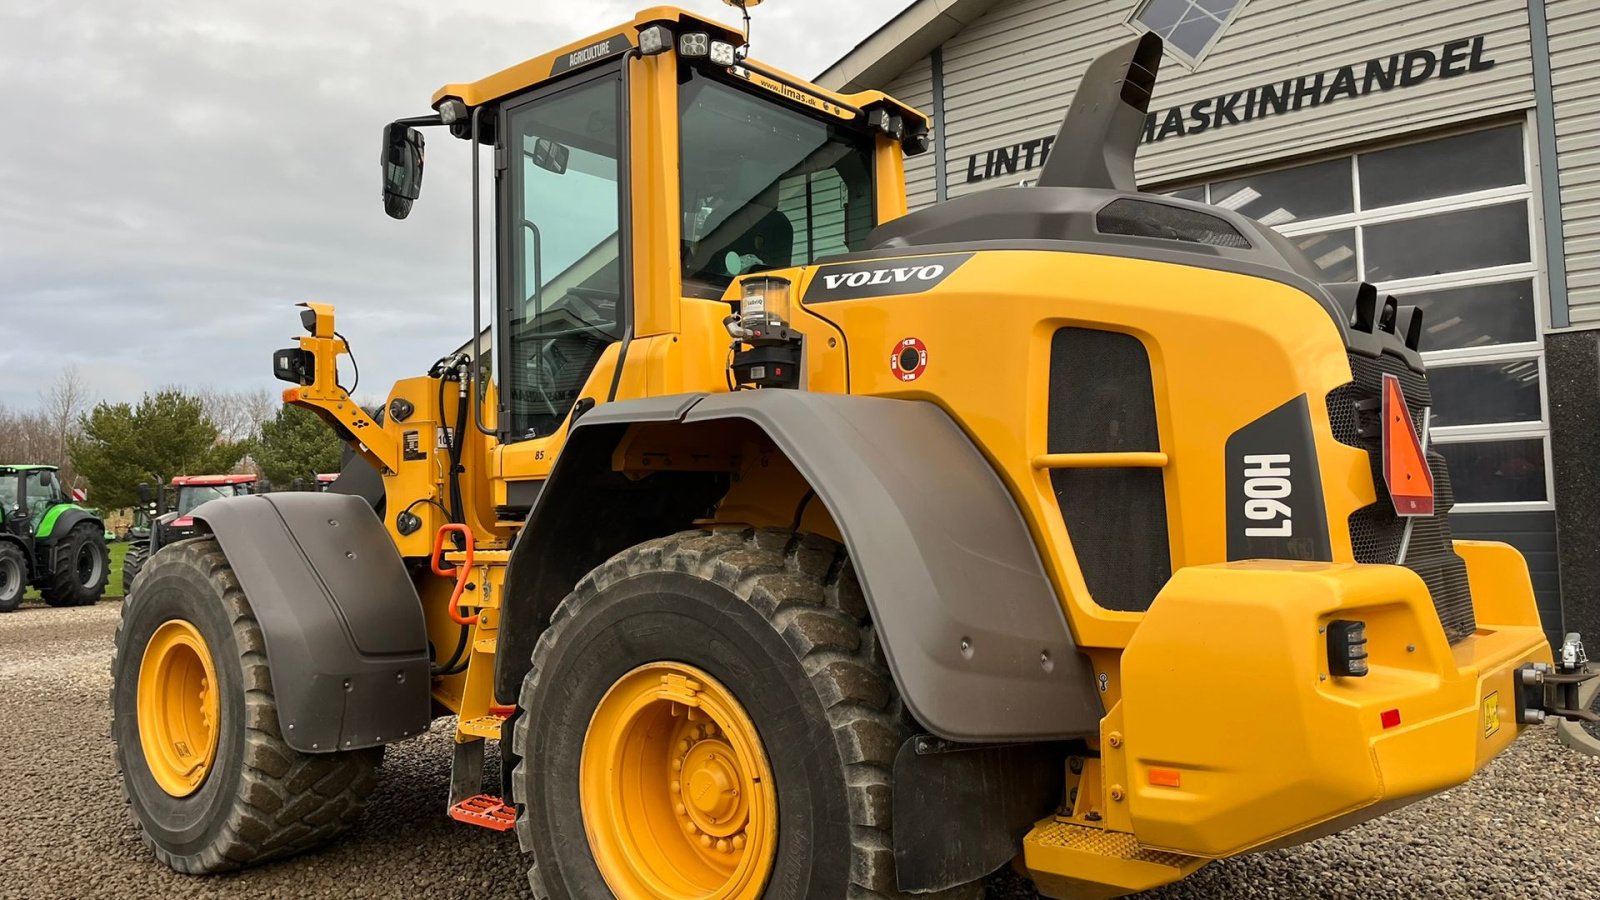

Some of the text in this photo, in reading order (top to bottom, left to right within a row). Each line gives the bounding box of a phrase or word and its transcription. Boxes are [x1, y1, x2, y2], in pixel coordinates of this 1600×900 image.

[569, 40, 610, 67] AGRICULTURE
[760, 79, 817, 106] www.limas.dk
[823, 264, 945, 290] VOLVO
[534, 450, 545, 460] 85
[1243, 453, 1293, 538] L90H
